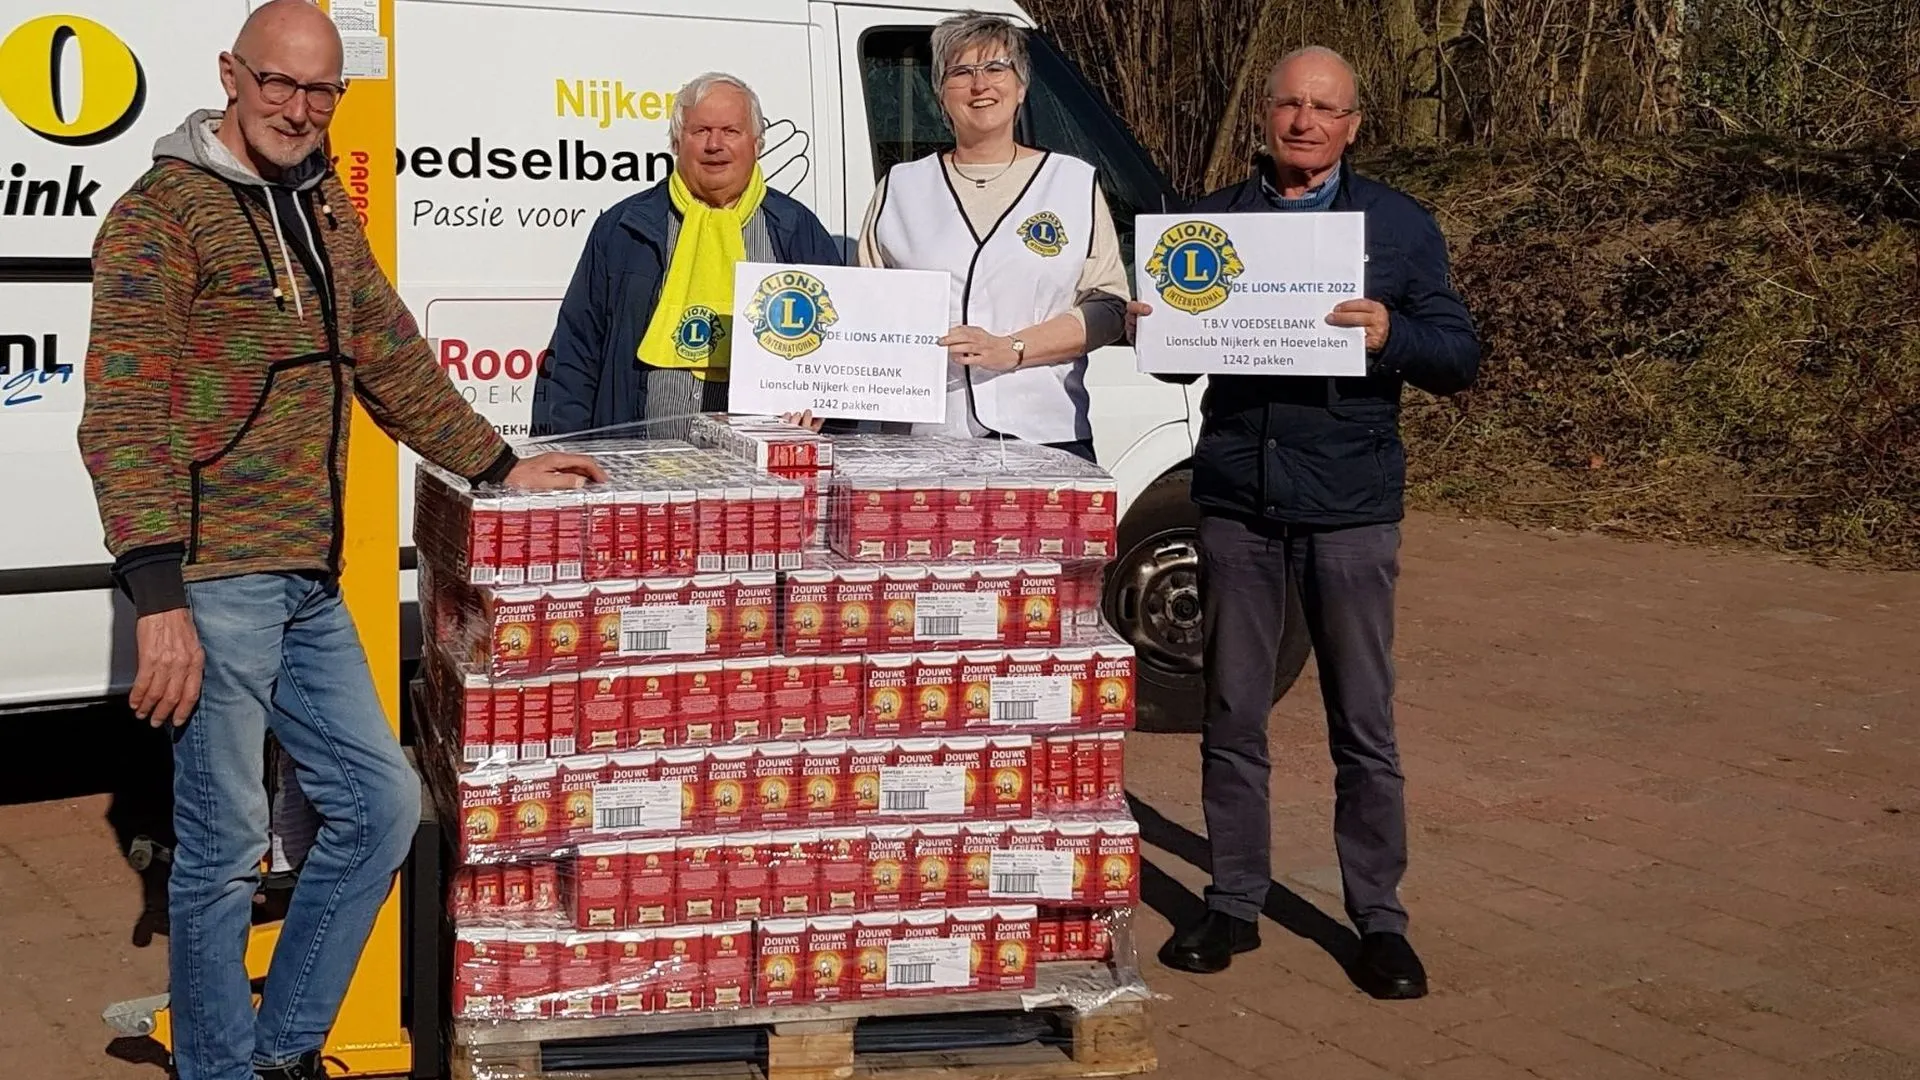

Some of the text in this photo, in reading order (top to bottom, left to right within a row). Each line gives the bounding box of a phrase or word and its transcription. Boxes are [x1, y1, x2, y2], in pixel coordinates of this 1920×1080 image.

[413, 197, 586, 228] Passie voor
[1167, 224, 1223, 244] LIONS
[1184, 250, 1209, 281] L
[765, 273, 820, 293] LIONS
[1233, 282, 1356, 293] DE LIONS AKTIE 2022
[1166, 289, 1223, 307] INTERNATIONAL
[781, 298, 804, 328] L
[1202, 318, 1316, 330] T.B.V VOEDSELBANK
[689, 323, 705, 342] L
[827, 331, 940, 345] DE LIONS AKTIE 2022
[763, 334, 817, 353] INTERNATIONAL
[1166, 335, 1348, 349] Lionsclub Nijkerk en Hoevelaken
[1222, 354, 1294, 367] 1242 pakken
[796, 363, 902, 378] T.B.V VOEDSELBANK
[760, 379, 931, 397] Lionsclub Nijkerk en Hoevelaken
[812, 398, 880, 412] 1242 pakken
[1020, 586, 1056, 595] EGBERTS
[735, 597, 772, 606] EGBERTS
[790, 593, 827, 602] EGBERTS
[837, 592, 873, 601] EGBERTS
[496, 613, 536, 624] EGBERTS
[545, 610, 584, 620] EGBERTS
[1095, 669, 1131, 678] EGBERTS
[869, 678, 907, 688] EGBERTS
[916, 676, 953, 685] EGBERTS
[990, 759, 1027, 767] EGBERTS
[709, 770, 747, 780] EGBERTS
[756, 767, 794, 777] EGBERTS
[802, 766, 840, 776] EGBERTS
[511, 791, 552, 802] EGBERTS
[1099, 845, 1134, 854] EGBERTS
[995, 930, 1031, 940] EGBERTS
[762, 945, 800, 954] EGBERTS
[809, 941, 847, 951] EGBERTS
